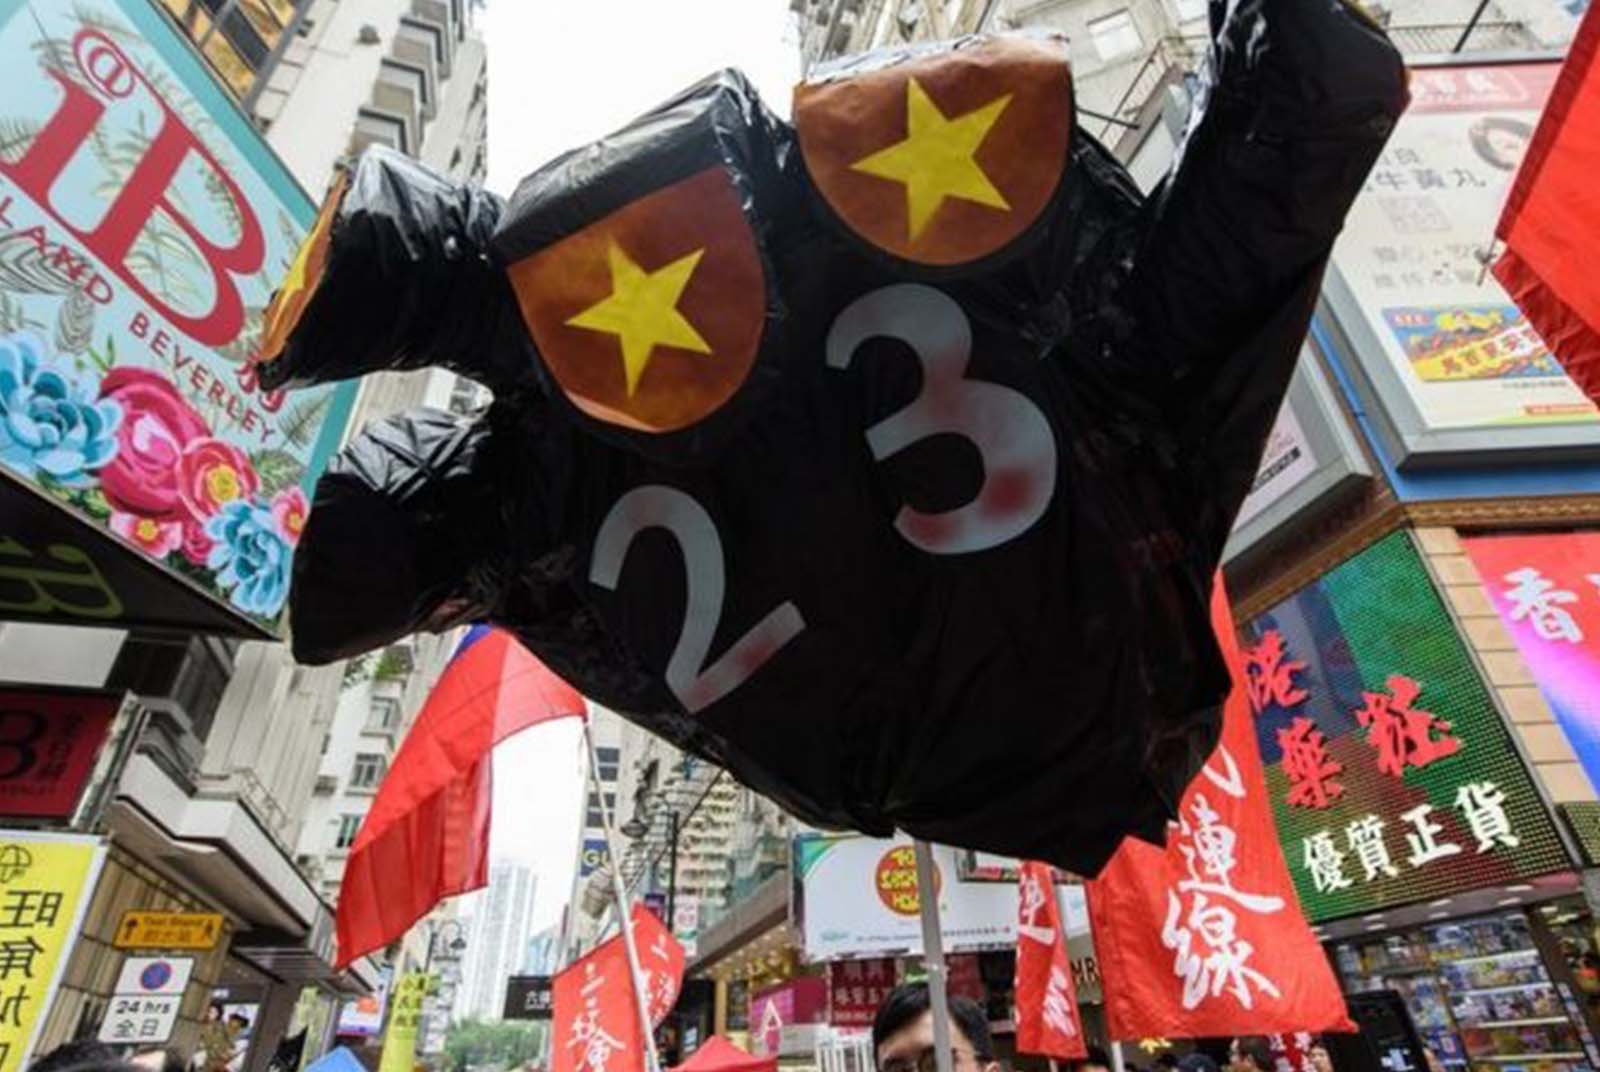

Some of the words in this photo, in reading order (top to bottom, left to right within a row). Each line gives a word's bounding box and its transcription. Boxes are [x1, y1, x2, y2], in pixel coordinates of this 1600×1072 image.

[129, 312, 275, 443] BEVERLEY
[589, 484, 806, 714] 2
[826, 282, 1058, 555] 3
[1303, 780, 1519, 893] 優質正貨
[113, 1018, 159, 1038] 全日
[115, 1000, 140, 1014] 24
[142, 1000, 171, 1014] hrs
